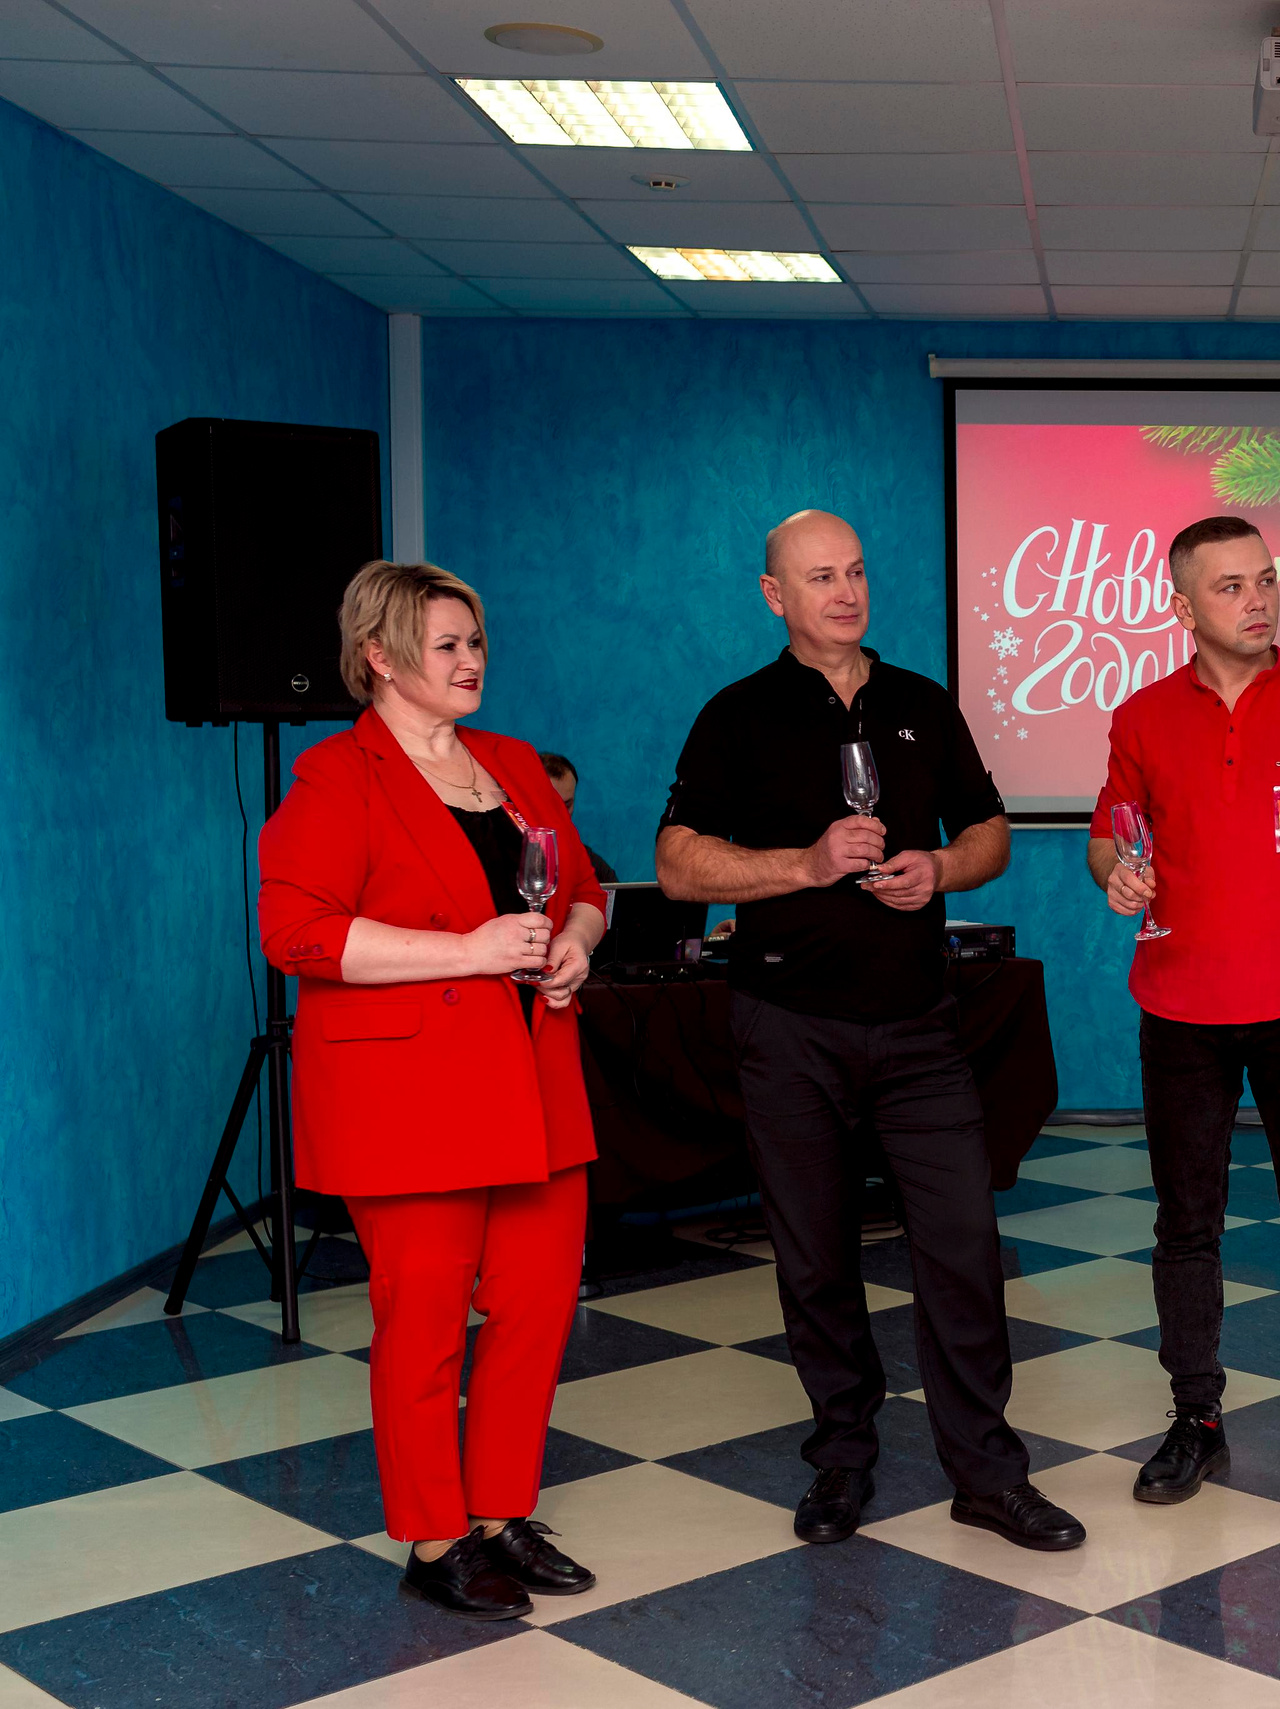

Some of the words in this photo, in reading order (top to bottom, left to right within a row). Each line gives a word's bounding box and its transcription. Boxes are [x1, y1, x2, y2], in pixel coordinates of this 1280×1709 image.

[1003, 526, 1060, 618] С
[1036, 518, 1177, 633] Новы
[1011, 619, 1196, 715] Годо
